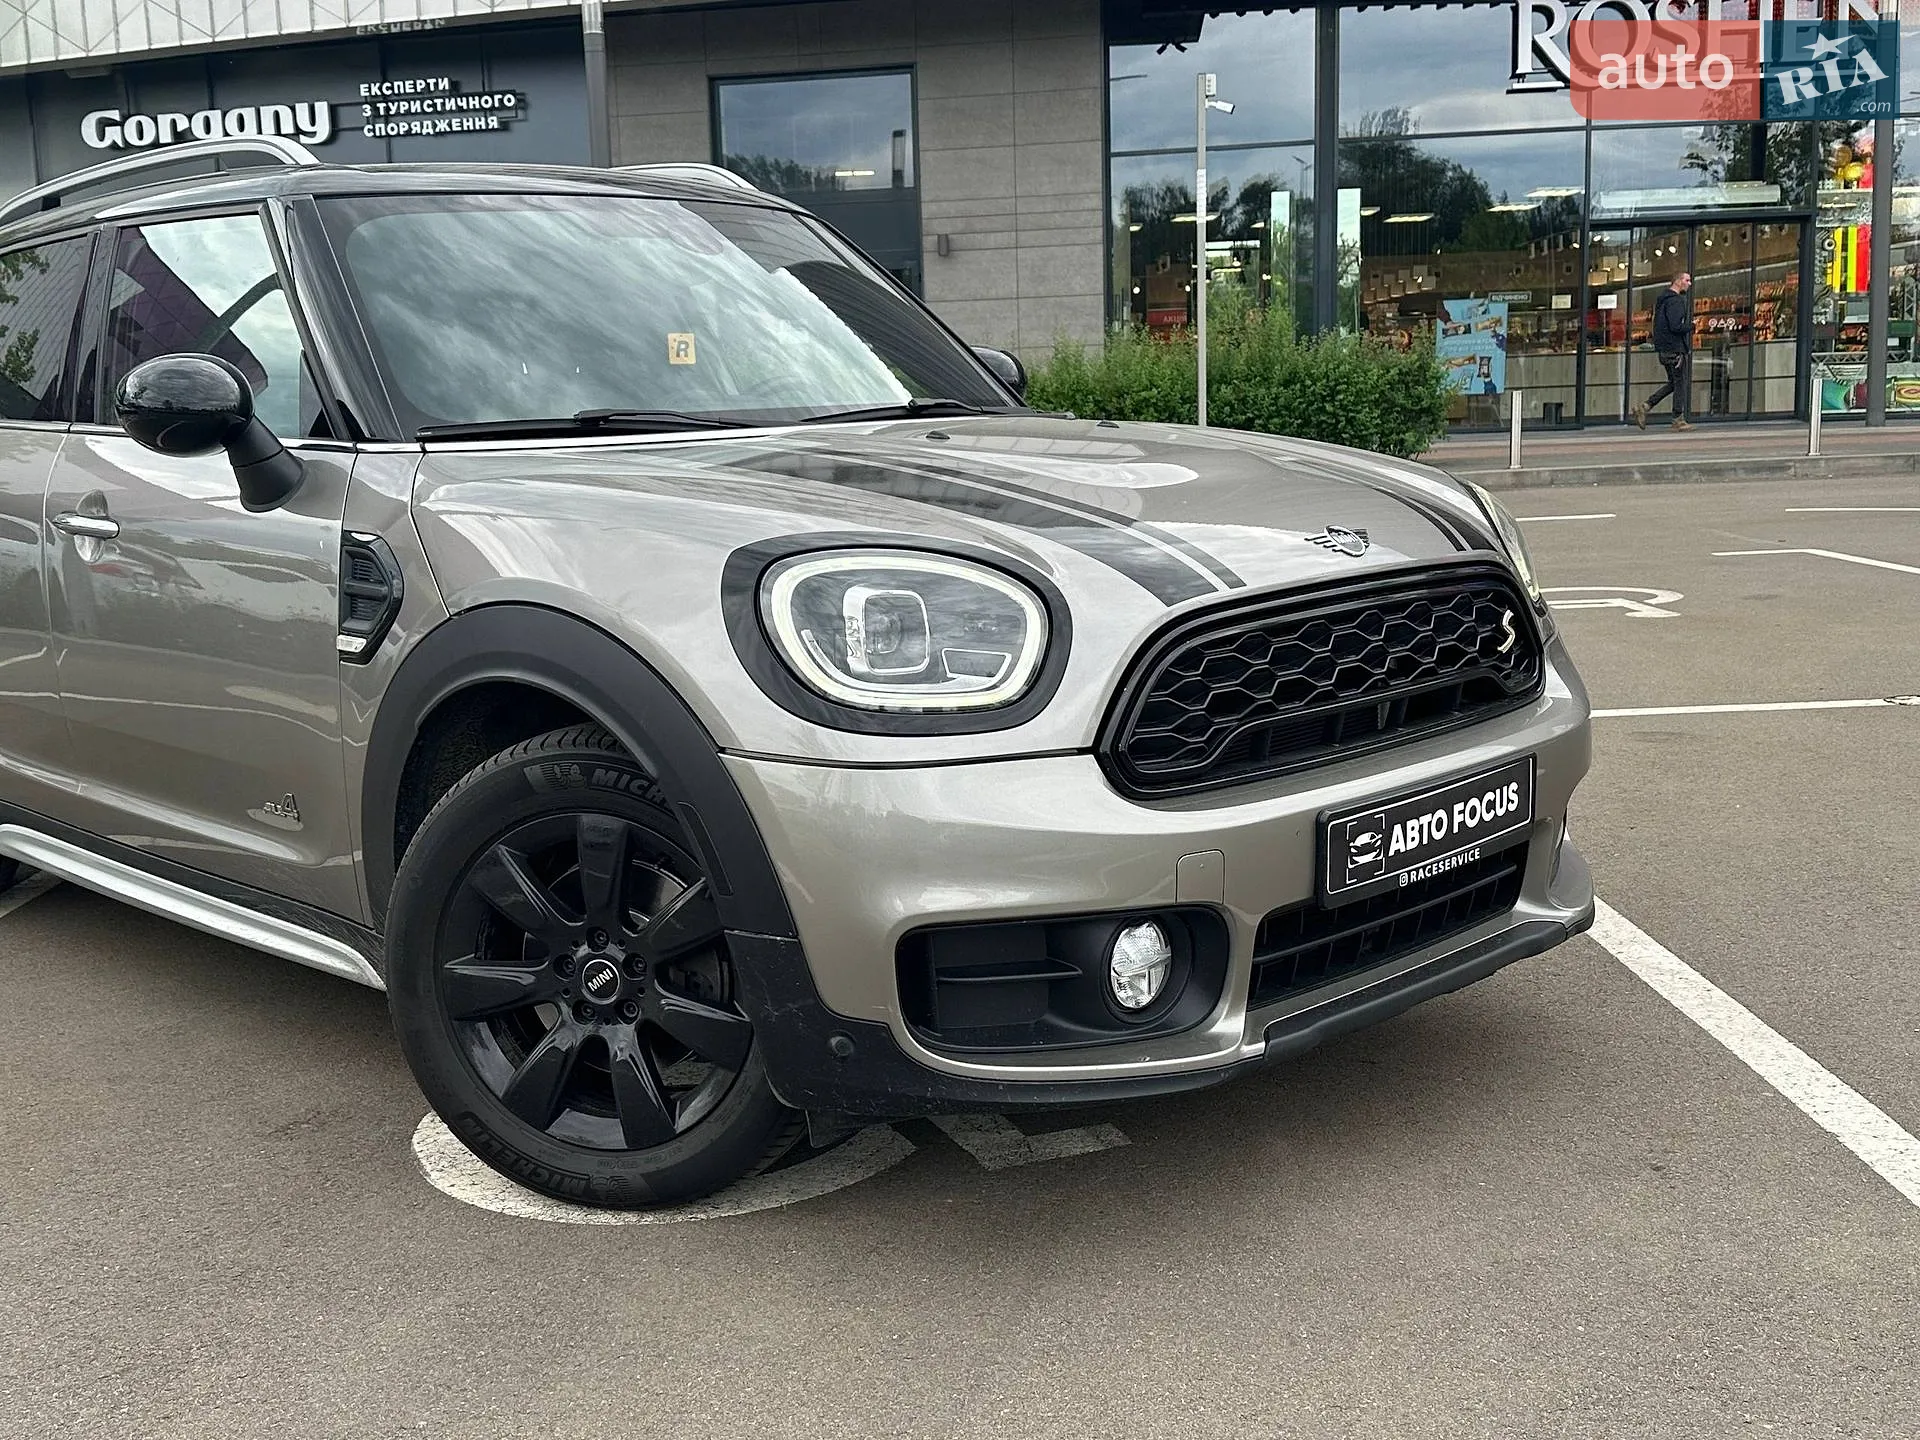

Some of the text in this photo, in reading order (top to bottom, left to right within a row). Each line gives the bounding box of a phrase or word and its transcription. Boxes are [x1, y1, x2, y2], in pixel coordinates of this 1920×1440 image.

[359, 77, 449, 97] ЕКСПЕРТИ
[377, 93, 516, 116] ТУРИСТИЧНОГО
[363, 116, 499, 137] СПОРЯДЖЕННЯ
[676, 340, 690, 358] R
[1453, 782, 1519, 834] FOCUS
[587, 968, 614, 992] MINI
